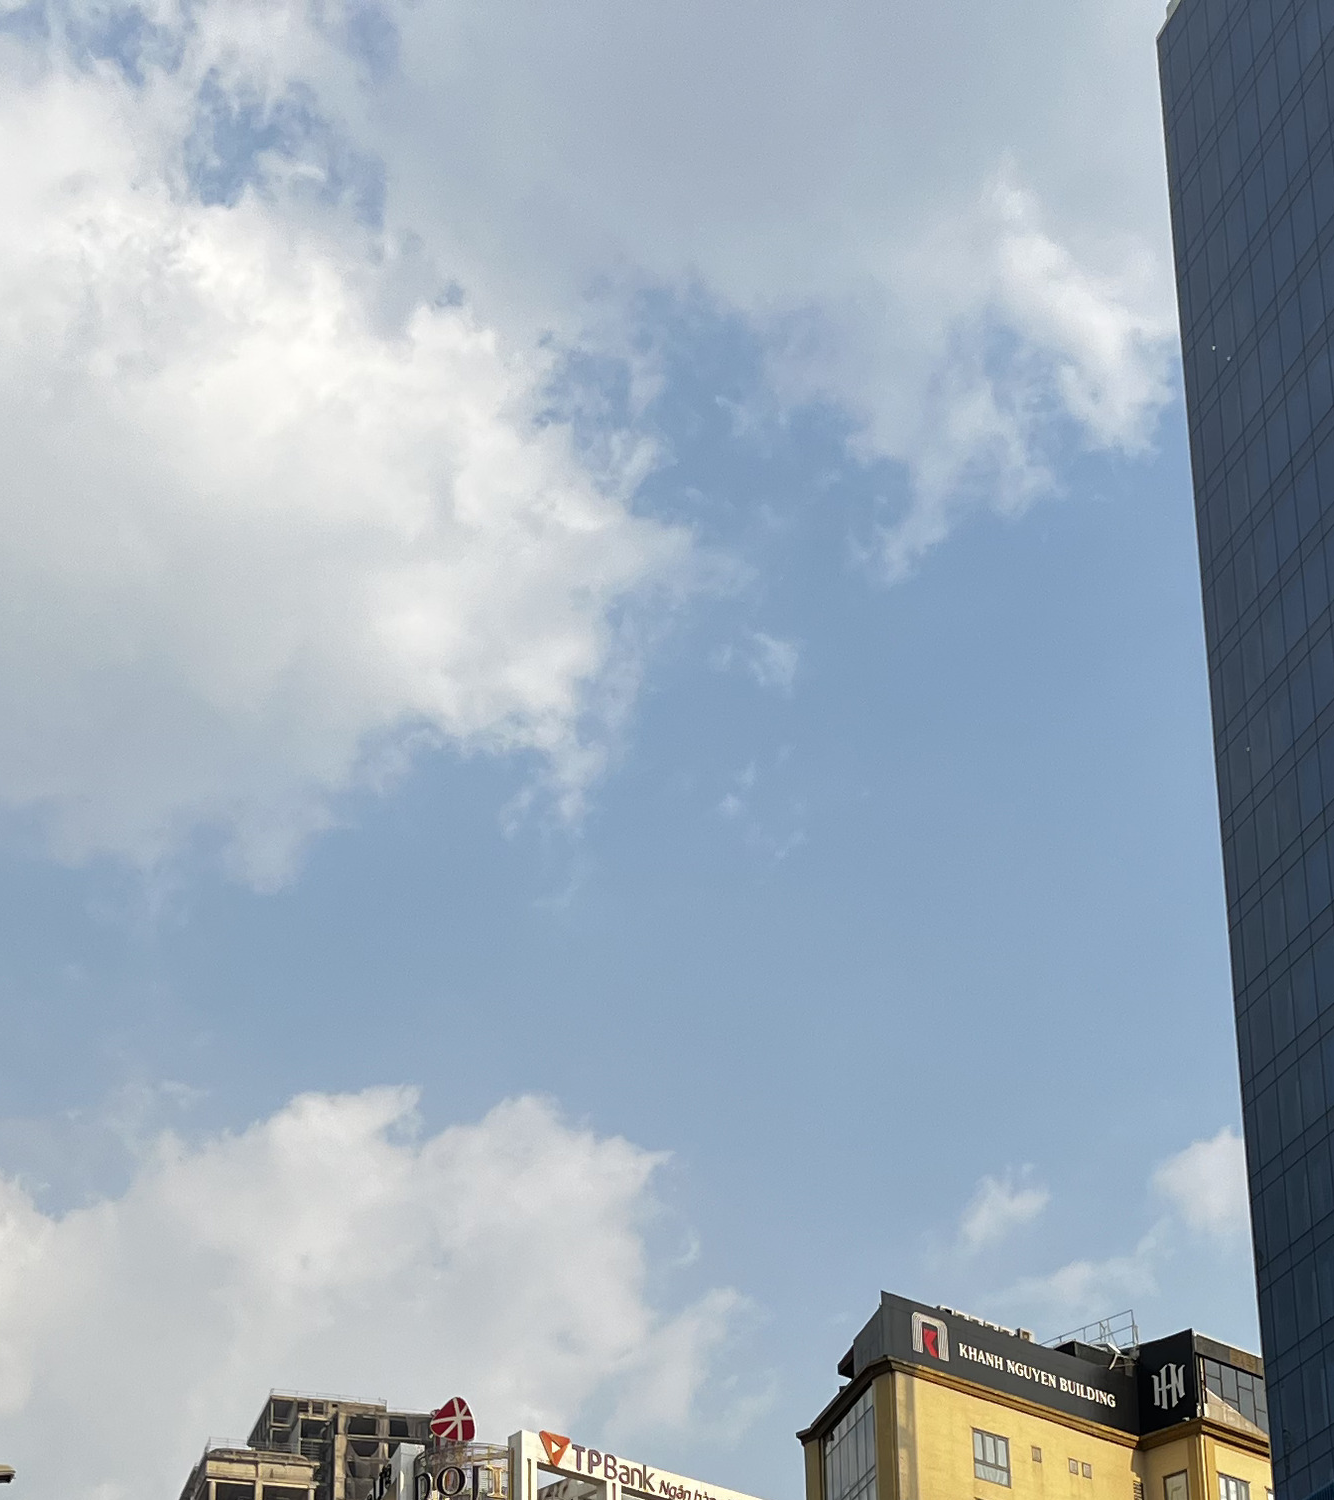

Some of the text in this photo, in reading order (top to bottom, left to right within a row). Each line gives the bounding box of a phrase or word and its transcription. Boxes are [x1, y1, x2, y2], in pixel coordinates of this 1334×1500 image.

[958, 1342, 1116, 1408] KHANH NGUYEN BUILDING
[571, 1443, 656, 1493] TPBank
